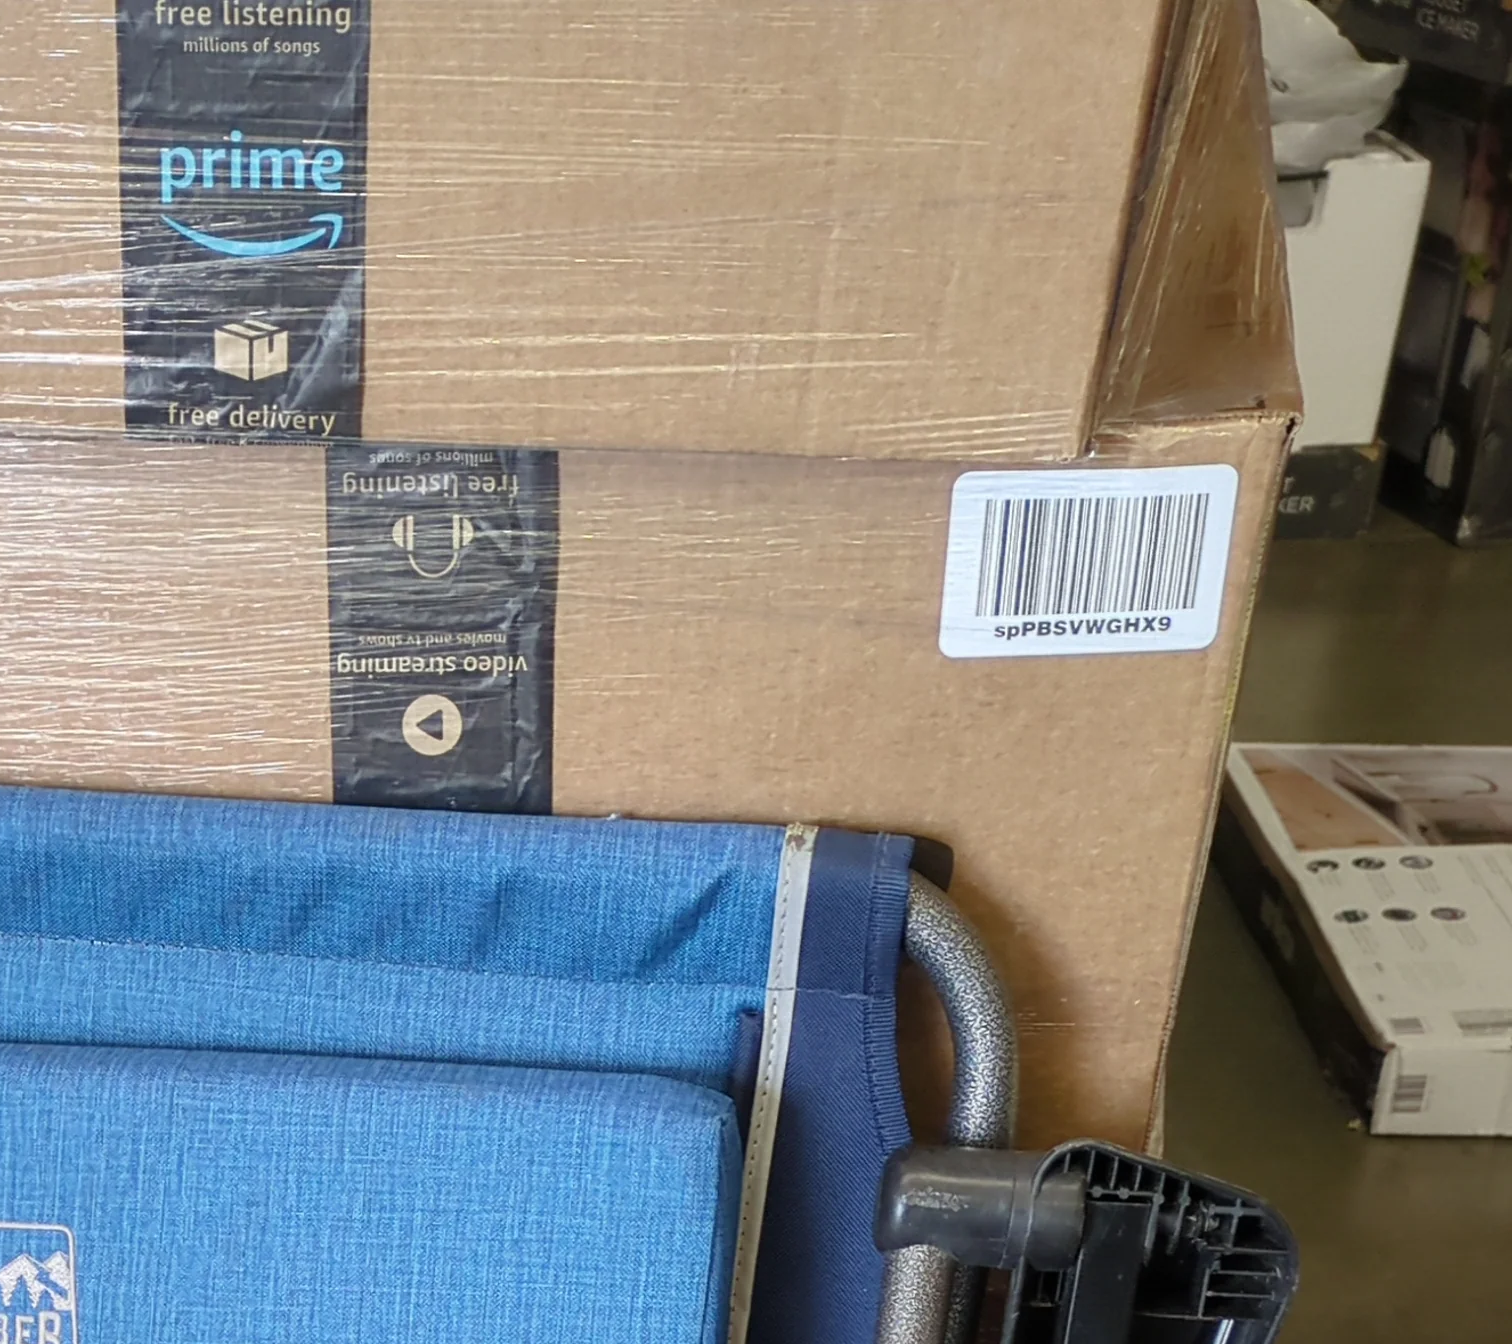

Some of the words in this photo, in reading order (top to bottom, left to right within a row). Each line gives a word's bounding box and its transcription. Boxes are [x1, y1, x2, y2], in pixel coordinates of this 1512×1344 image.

[155, 0, 213, 26] free
[223, 0, 352, 34] listening
[183, 37, 249, 53] millions
[252, 37, 270, 53] of
[274, 40, 321, 57] songs
[159, 130, 345, 204] prime
[168, 402, 220, 426] free
[229, 404, 336, 437] delivery
[415, 452, 431, 466] of
[436, 451, 493, 467] millions
[342, 471, 459, 499] listening
[468, 473, 520, 500] free
[456, 632, 507, 647] movies
[993, 616, 1173, 641] spPBSVWGHX9
[358, 634, 403, 648] shows
[406, 635, 421, 646] tv
[425, 634, 452, 648] and
[337, 653, 458, 680] streaming
[464, 655, 529, 678] video
